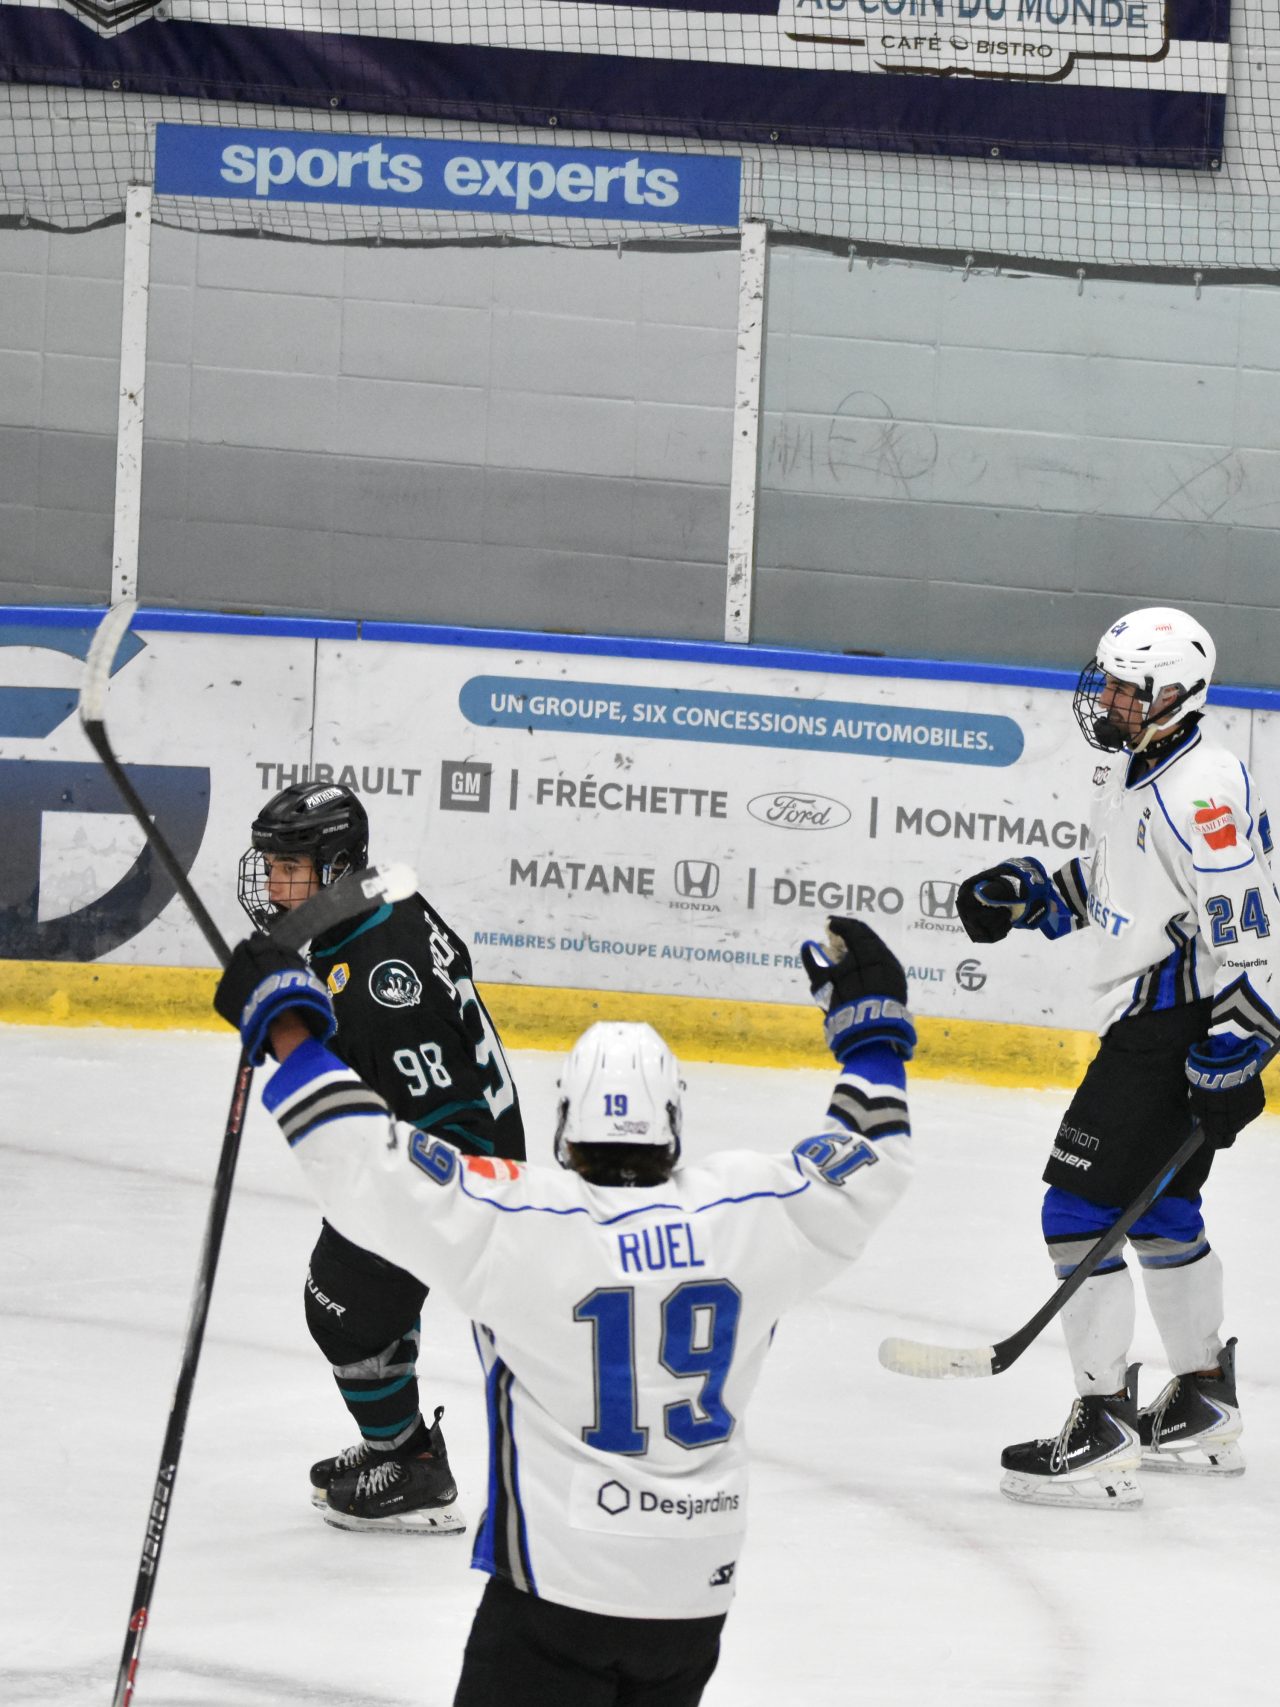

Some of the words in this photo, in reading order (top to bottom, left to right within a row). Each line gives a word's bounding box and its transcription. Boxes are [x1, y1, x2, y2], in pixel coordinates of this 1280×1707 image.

[1017, 0, 1148, 29] MONDE
[881, 33, 942, 51] CAFÉ
[976, 40, 1053, 58] BISTRO
[220, 142, 423, 195] sports
[444, 154, 679, 209] experts
[490, 693, 523, 713] UN
[529, 696, 627, 724] GROUPE,
[633, 703, 667, 724] SIX
[672, 706, 827, 737] CONCESSIONS
[832, 719, 994, 751] AUTOMOBILES.
[256, 762, 422, 797] THIBAULT
[451, 771, 481, 794] GM
[537, 775, 728, 819] FRÉCHETTE
[766, 794, 831, 826] Ford
[509, 859, 656, 896] MATANE
[668, 901, 721, 912] HONDA
[773, 877, 905, 914] DEGIRO
[1205, 886, 1271, 948] 24
[473, 932, 556, 950] MEMBRES
[560, 937, 584, 951] DU
[588, 940, 658, 957] GROUPE
[661, 944, 770, 967] AUTOMOBILE
[1227, 957, 1268, 969] Desjardins
[393, 1041, 452, 1097] 98
[603, 1093, 628, 1117] 19
[617, 1222, 705, 1273] RUEL
[573, 1278, 743, 1456] 19
[640, 1490, 740, 1521] Desjardins
